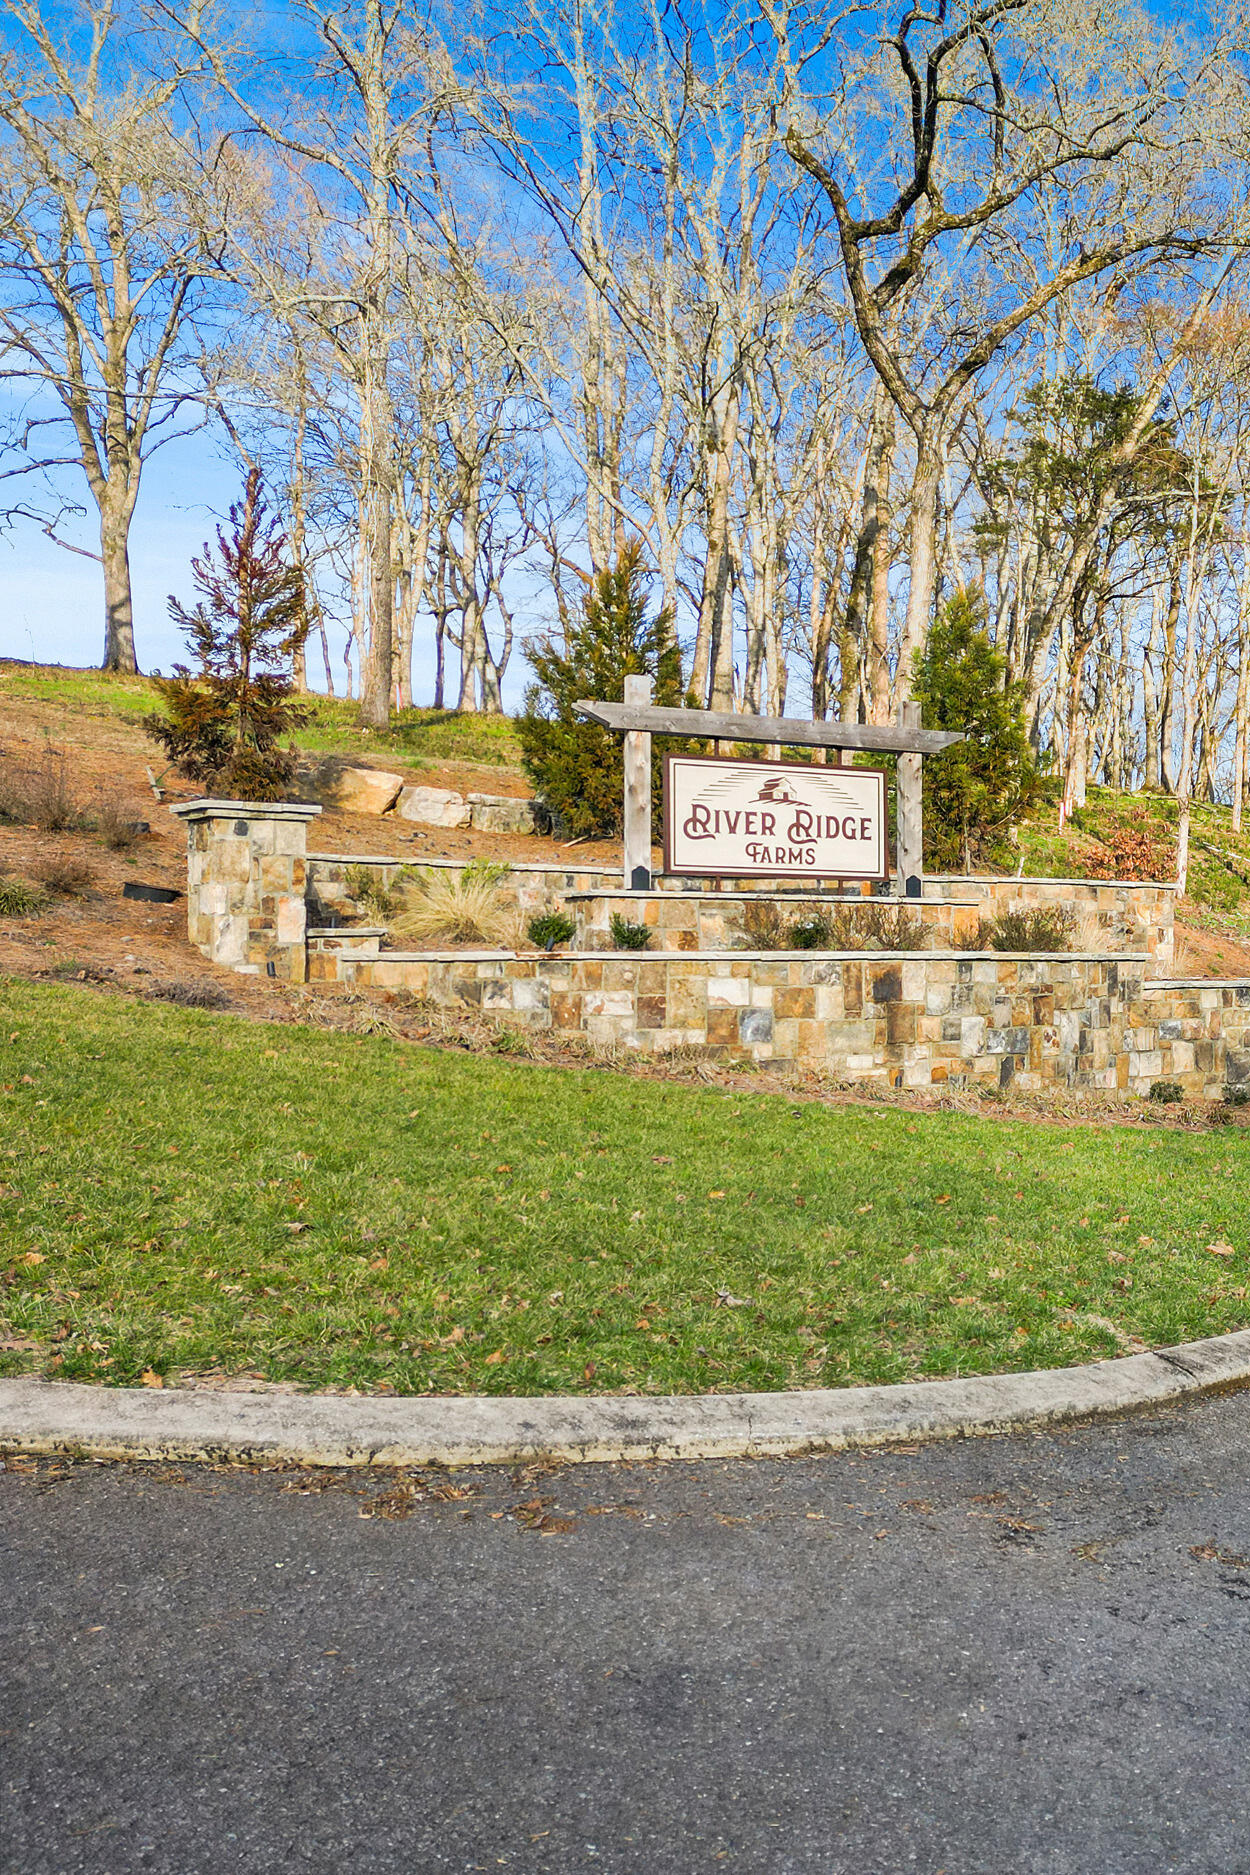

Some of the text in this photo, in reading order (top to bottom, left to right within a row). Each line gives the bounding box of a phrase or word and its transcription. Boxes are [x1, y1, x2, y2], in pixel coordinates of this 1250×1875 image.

[683, 804, 872, 844] RIVER RIDGE
[745, 842, 816, 865] FARMS
